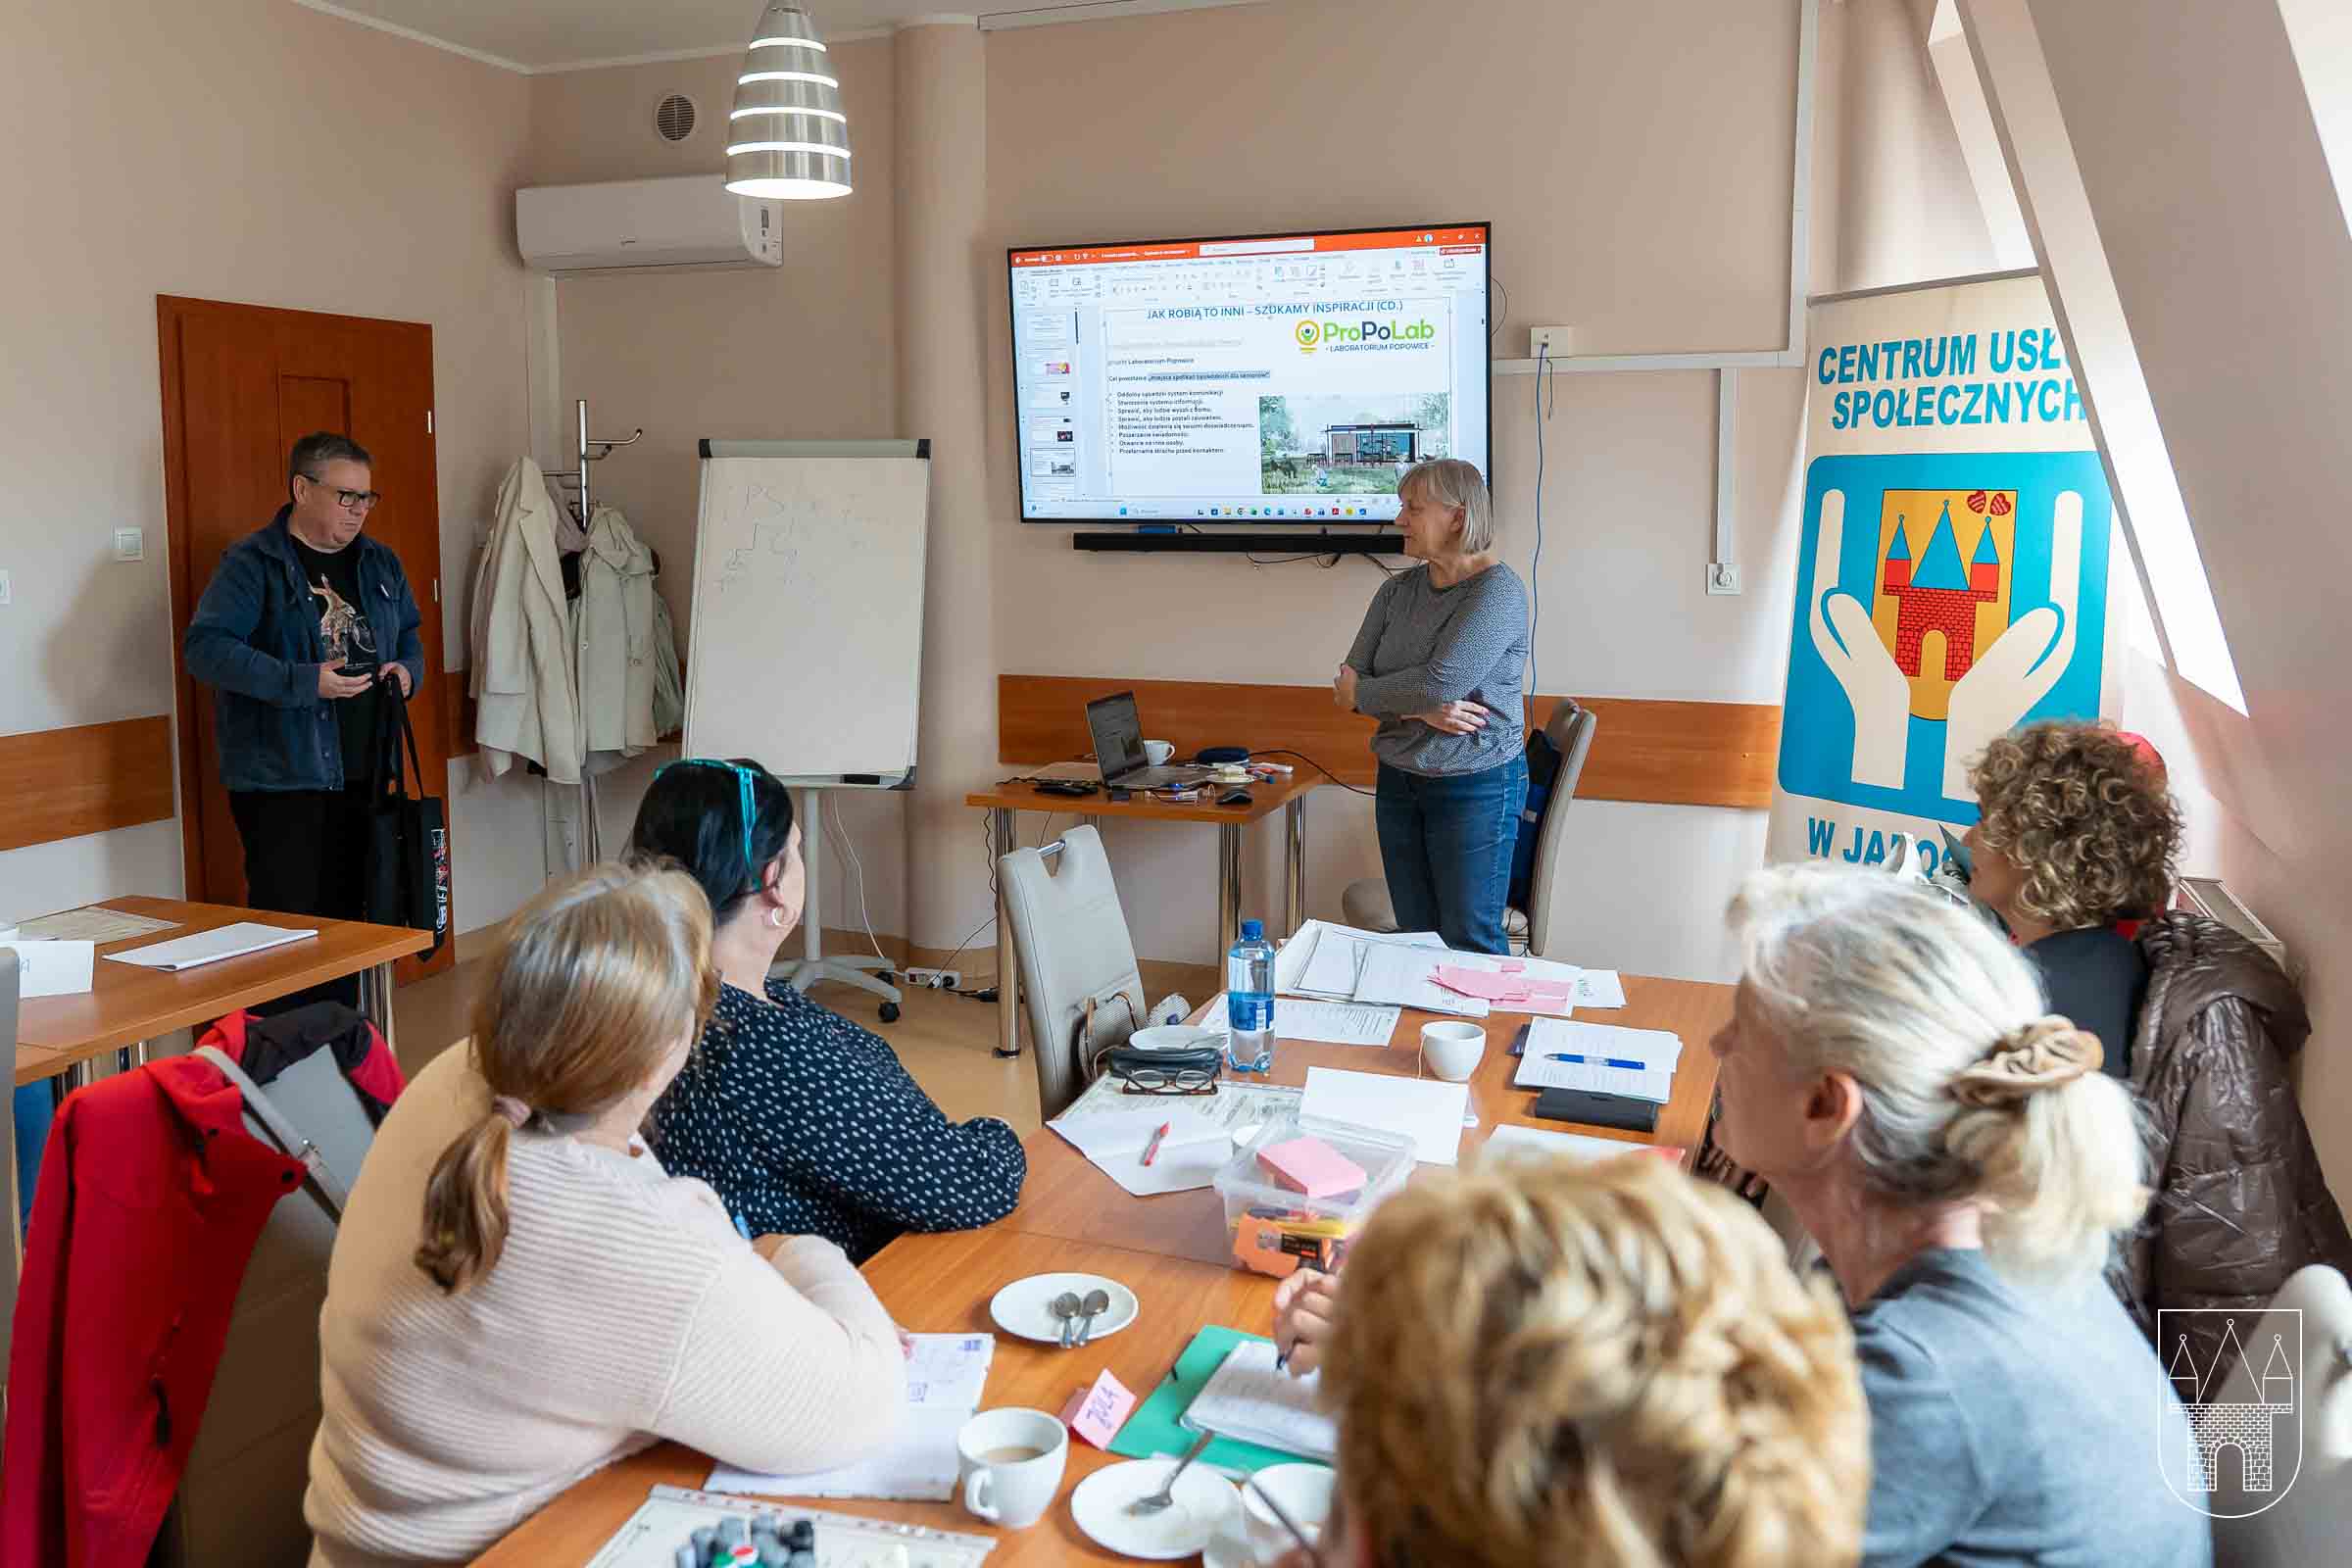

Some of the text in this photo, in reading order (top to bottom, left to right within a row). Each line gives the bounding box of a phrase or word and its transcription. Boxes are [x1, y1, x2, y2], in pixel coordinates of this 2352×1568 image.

[1147, 310, 1166, 319] JAK
[1168, 309, 1201, 320] ROBIĄ
[1204, 308, 1218, 318] TO
[1220, 307, 1245, 317] INNI
[1254, 304, 1310, 316] SZUKAMY
[1312, 302, 1374, 314] INSPIRACJI
[1323, 318, 1435, 342] ProPoLab
[1330, 342, 1429, 353] LABORATORIUM POPOWICE
[1818, 327, 2071, 385] CENTRUM USŁ
[1832, 377, 2087, 430] SPOŁECZNYCH
[1807, 816, 1836, 858] W
